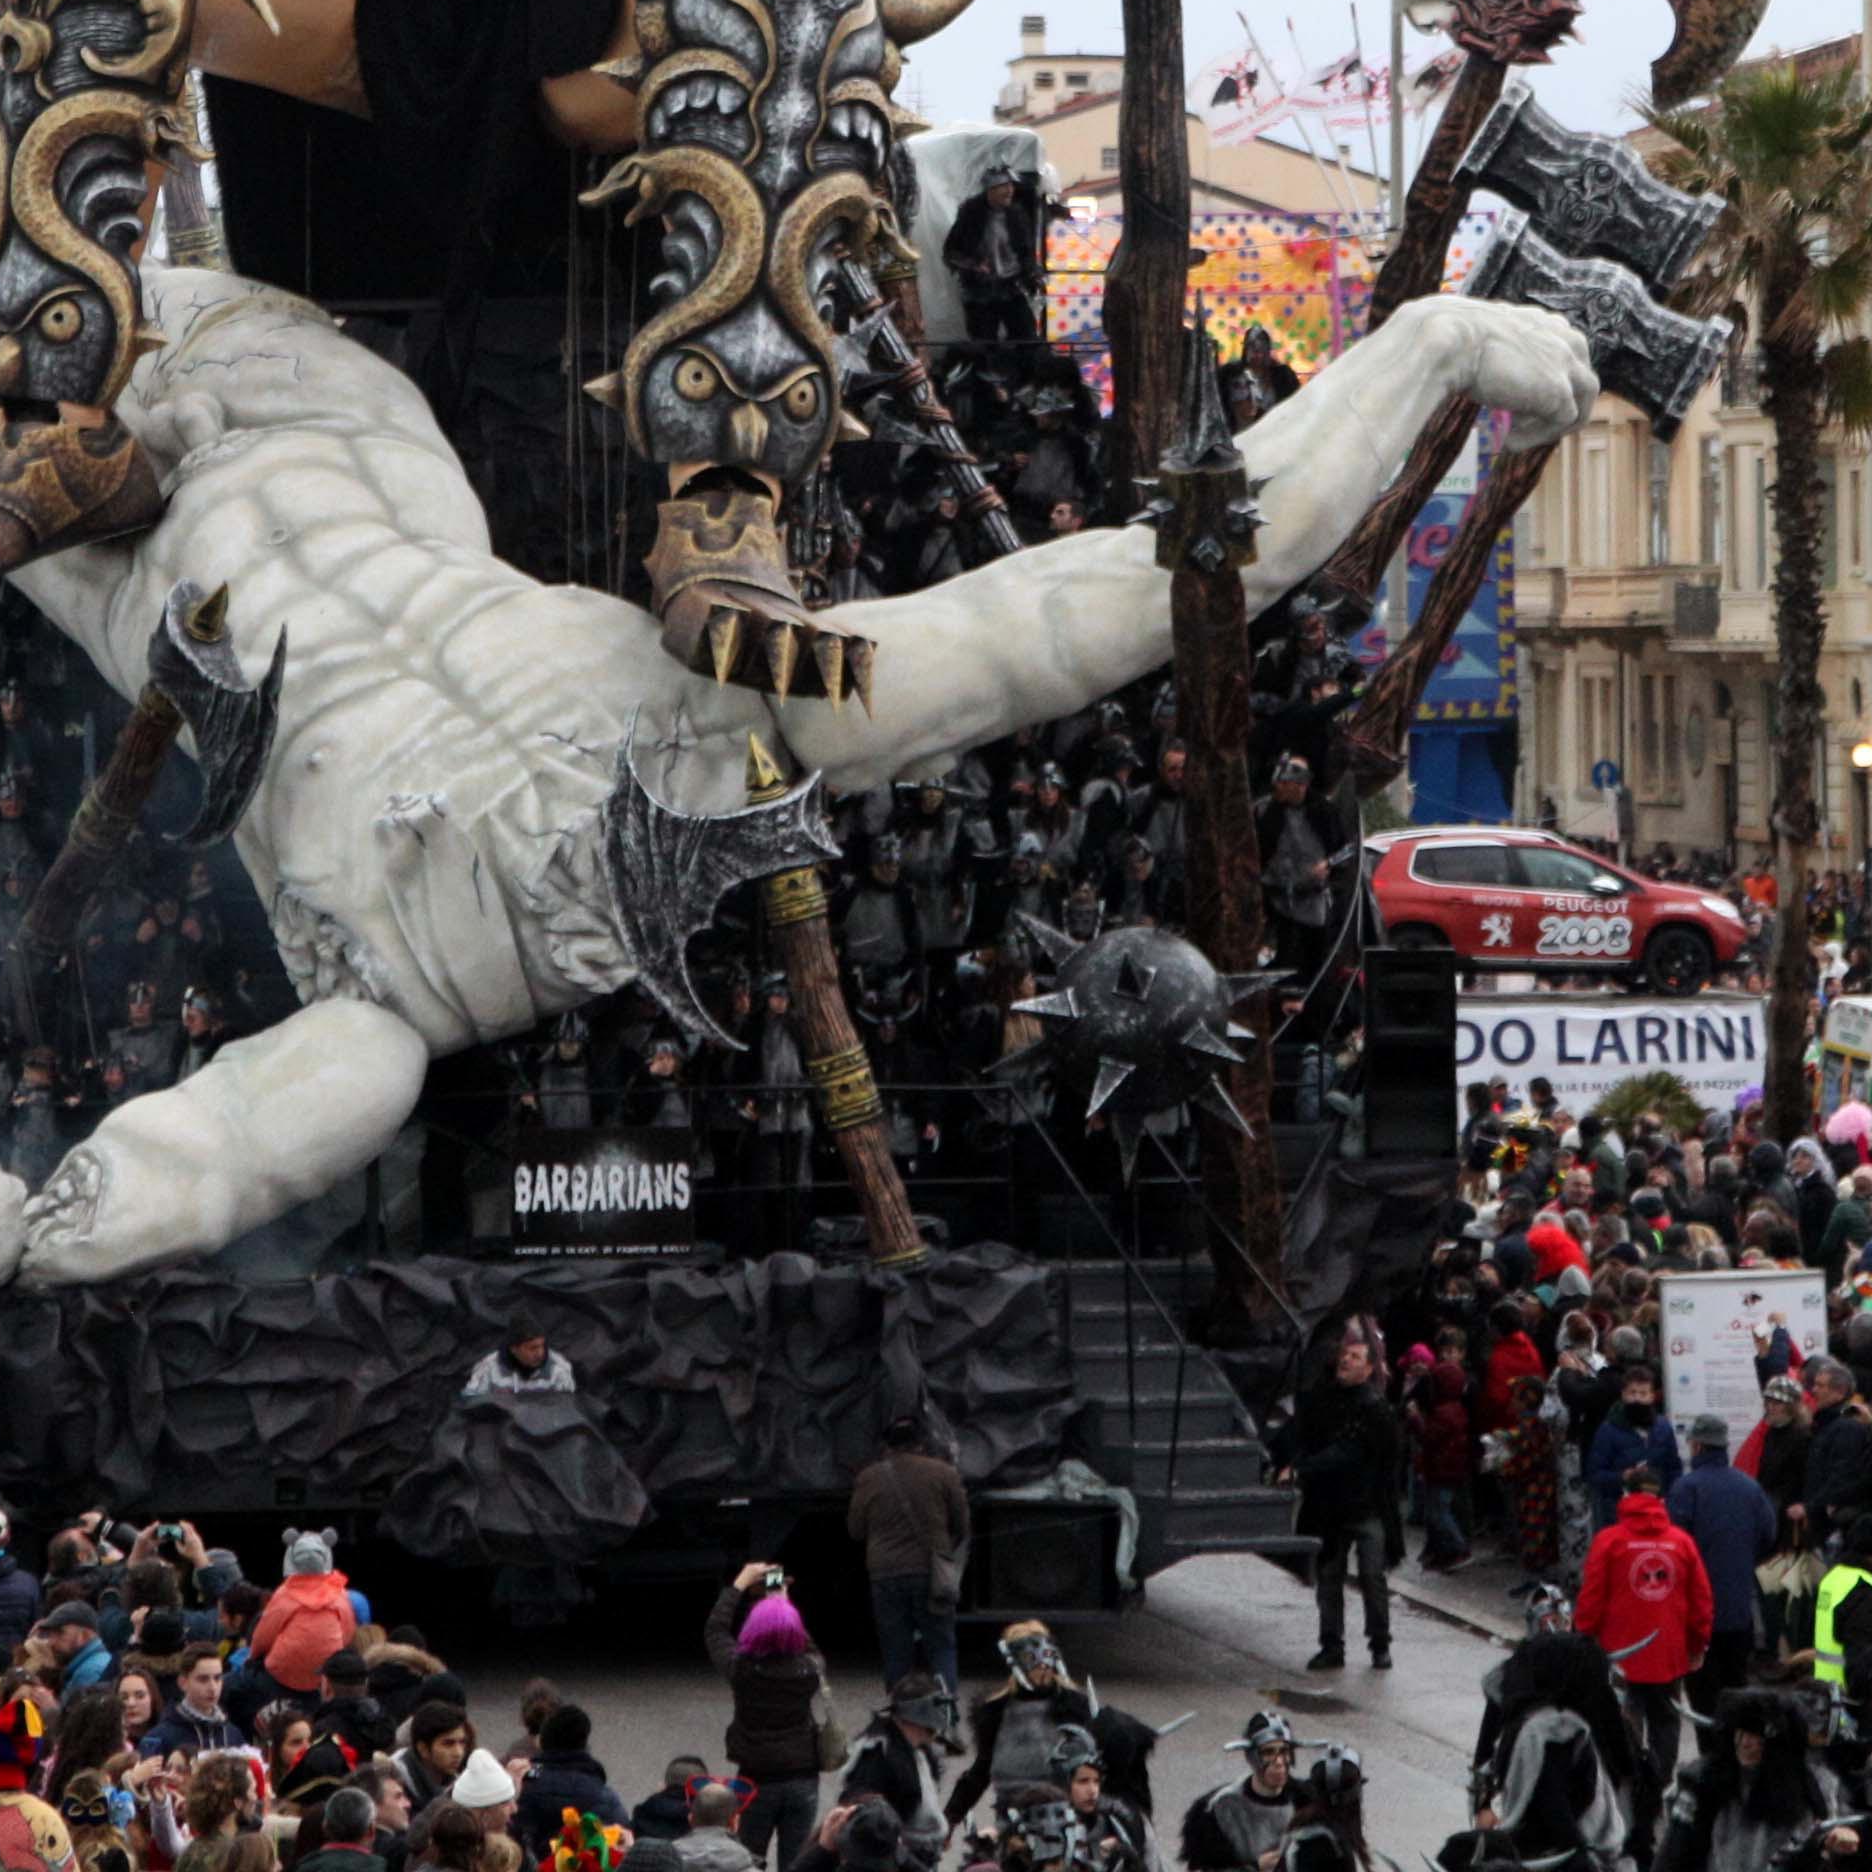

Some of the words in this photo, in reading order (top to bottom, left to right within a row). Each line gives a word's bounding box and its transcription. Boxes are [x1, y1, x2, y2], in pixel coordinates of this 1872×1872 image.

[1542, 895, 1629, 914] PEUGEOT
[1555, 1014, 1756, 1066] LARINI
[514, 1162, 691, 1215] BARBARIANS
